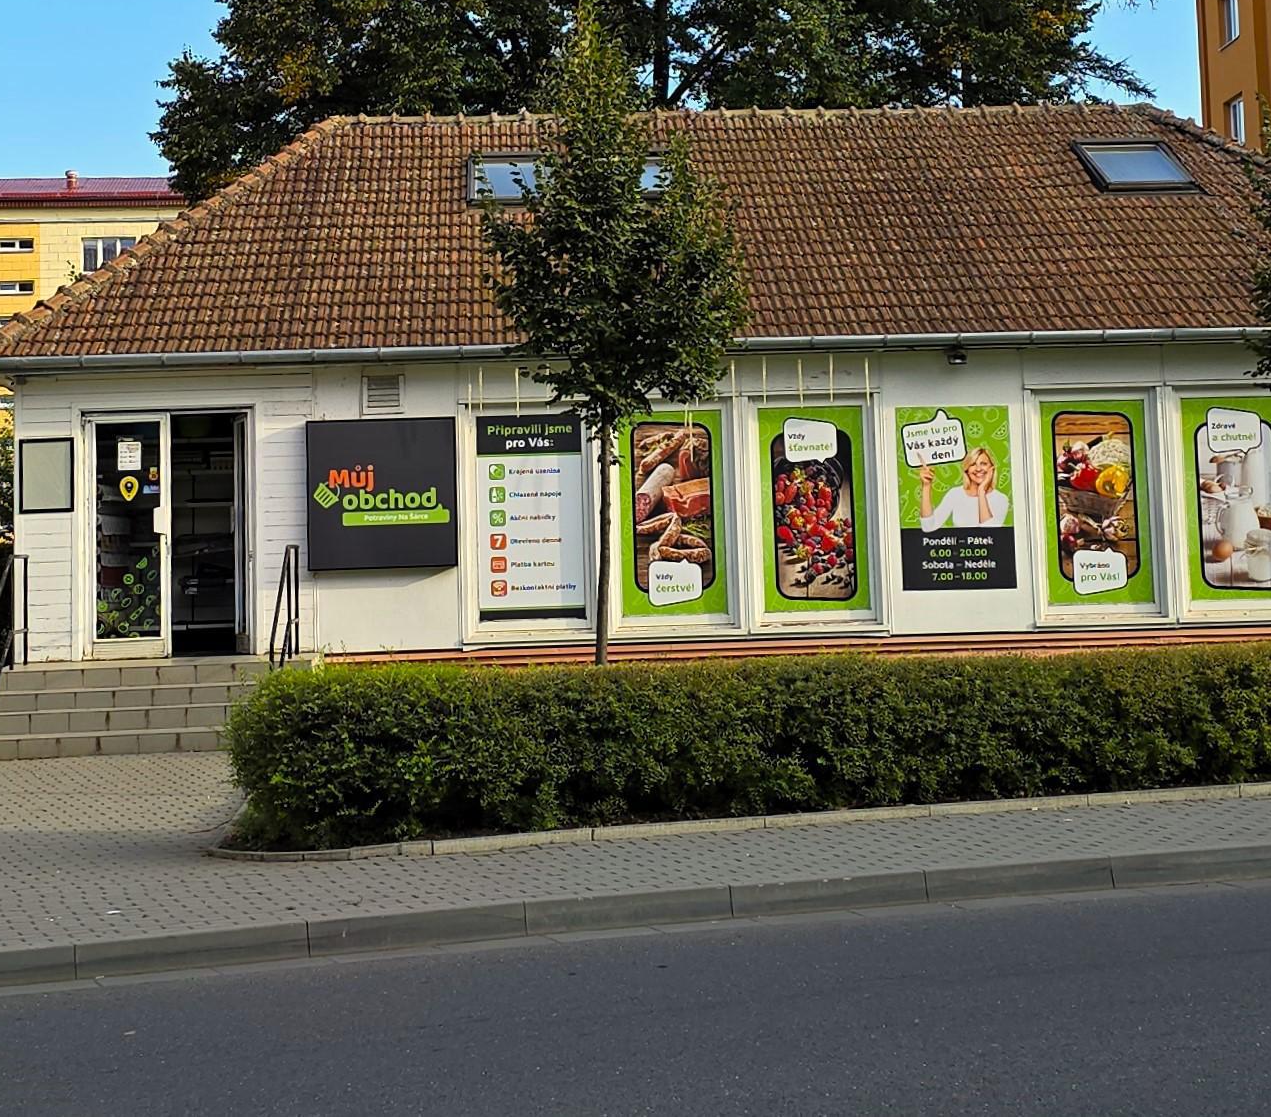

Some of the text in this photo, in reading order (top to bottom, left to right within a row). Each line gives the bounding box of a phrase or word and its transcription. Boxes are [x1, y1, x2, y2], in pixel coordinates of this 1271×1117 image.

[487, 424, 573, 437] Připravili jsme
[906, 425, 958, 438] Jsme tu pro
[1221, 433, 1256, 441] chutné!
[505, 437, 554, 450] pro Vás:
[906, 435, 959, 451] Vás každý
[931, 449, 954, 460] den!
[328, 465, 375, 492] Můj
[342, 487, 437, 510] obchod
[363, 514, 398, 522] Potraviny
[398, 513, 409, 521] Na
[922, 536, 957, 546] Pondělí
[967, 536, 994, 545] Pátek
[929, 549, 952, 557] 6.00
[959, 548, 988, 557] 20.00
[922, 561, 954, 569] Sobota
[964, 559, 997, 569] Neděle
[932, 572, 953, 581] 7.00
[961, 572, 988, 580] 18.00
[1081, 572, 1120, 583] pro Vás!
[656, 583, 695, 593] čerstvé!
